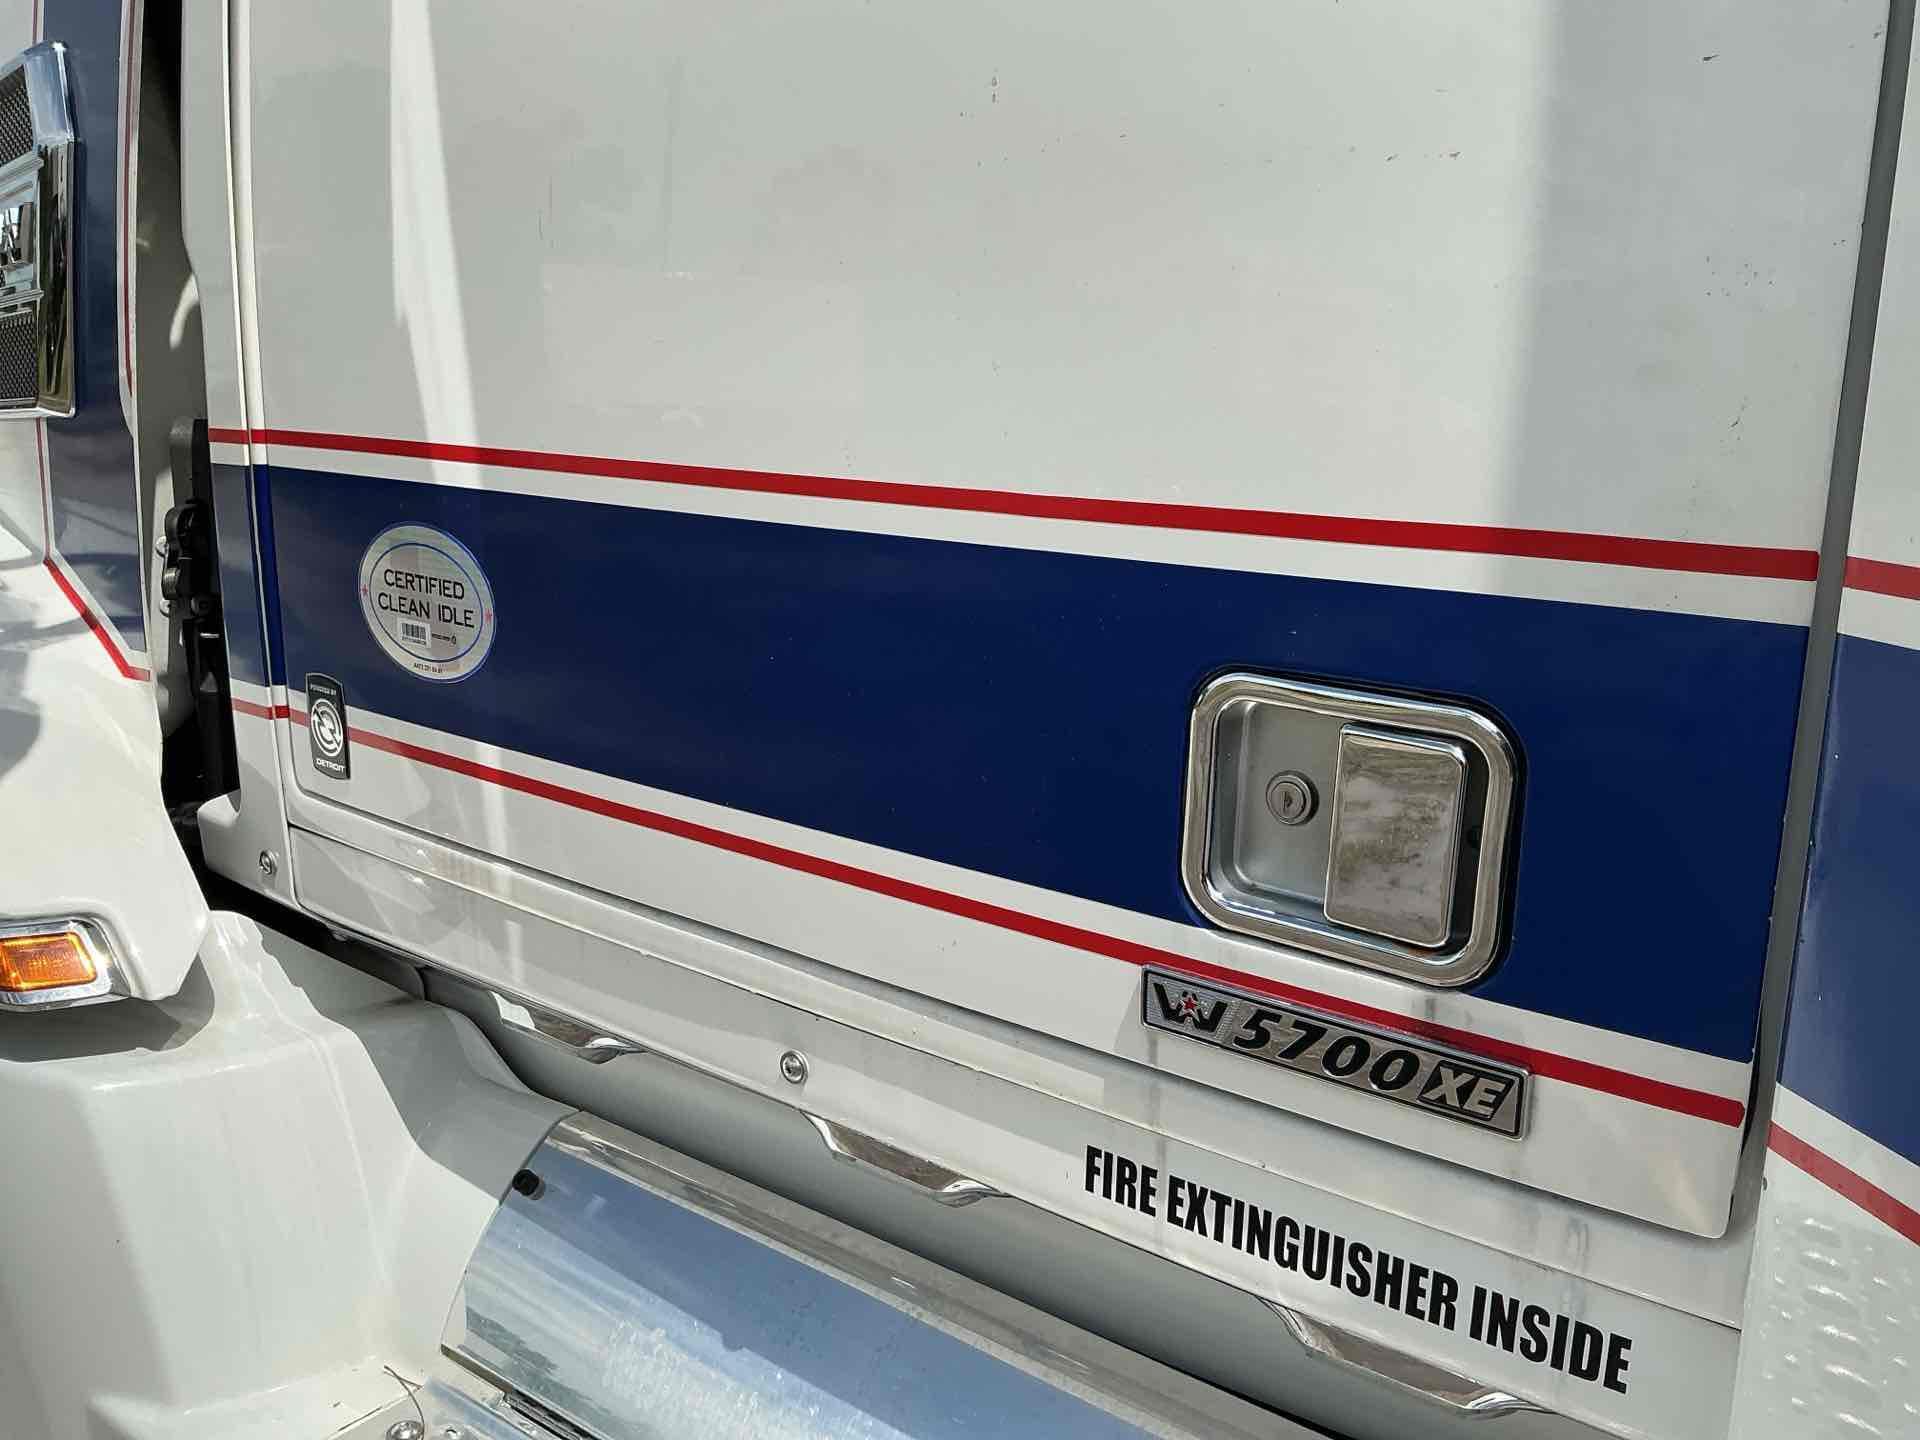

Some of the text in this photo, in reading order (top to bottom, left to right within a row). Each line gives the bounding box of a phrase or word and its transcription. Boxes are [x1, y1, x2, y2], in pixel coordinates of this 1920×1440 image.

[383, 568, 465, 600] CERTIFIED
[378, 592, 475, 628] CLEAN IDLE
[316, 758, 345, 773] DETROIT
[1084, 1144, 1633, 1394] FIRE EXTINGUISHER INSIDE
